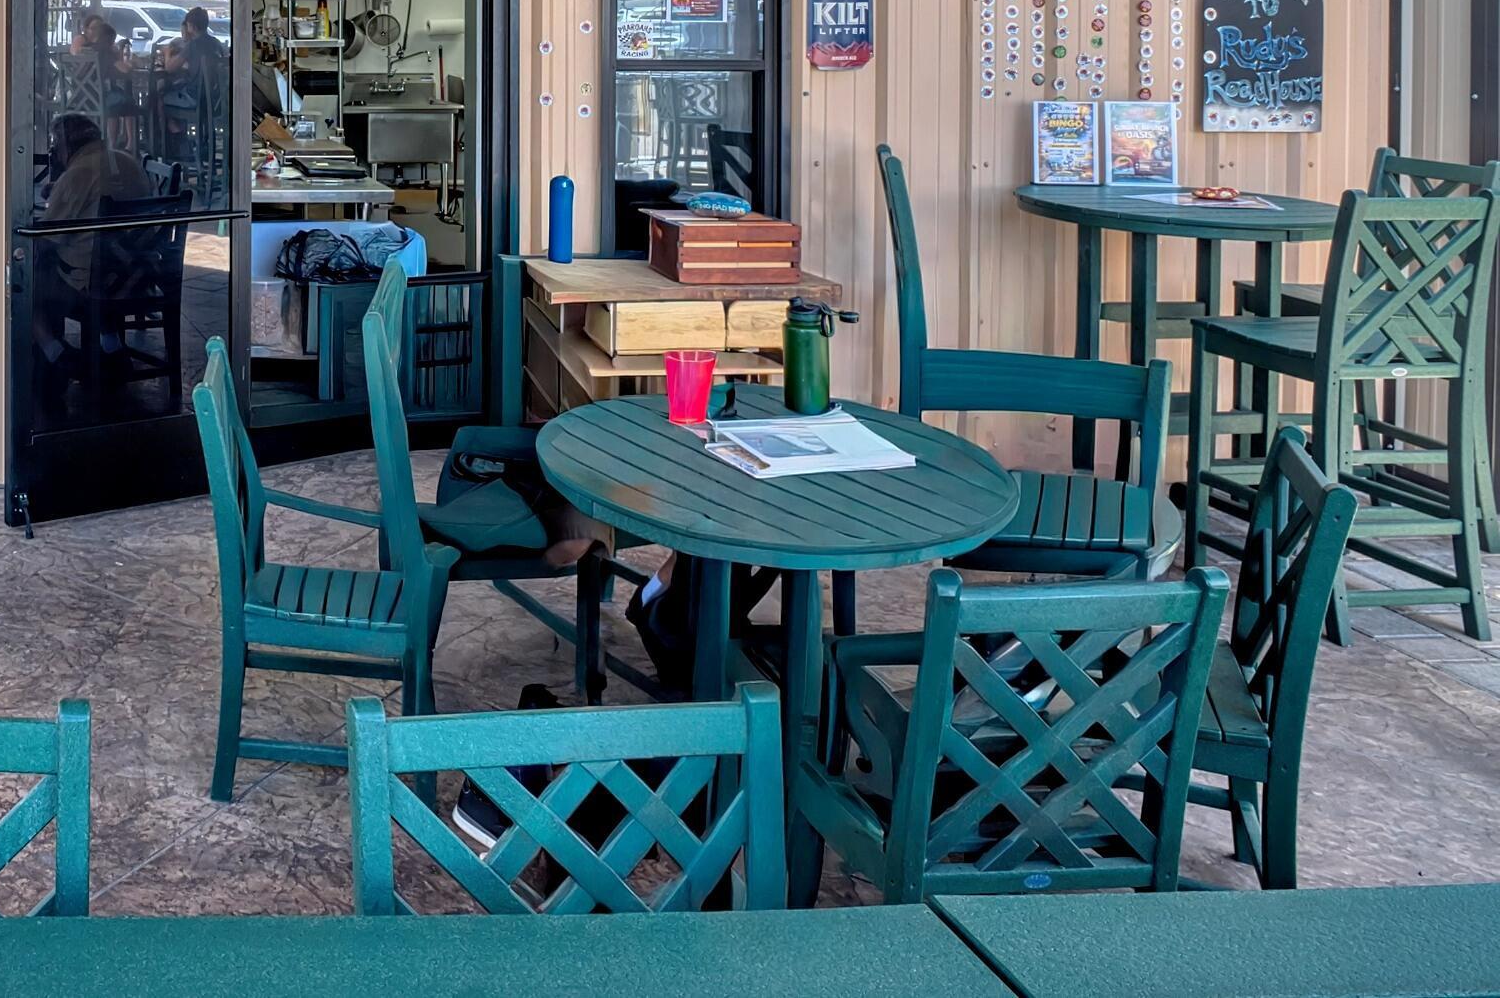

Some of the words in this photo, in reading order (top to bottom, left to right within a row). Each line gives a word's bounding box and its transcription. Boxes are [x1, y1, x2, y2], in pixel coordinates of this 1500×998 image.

[813, 2, 869, 26] KILT
[819, 27, 866, 35] LIFTER
[1216, 20, 1309, 71] Rudy's
[1049, 119, 1084, 129] BINGO
[1125, 131, 1154, 139] OASIS
